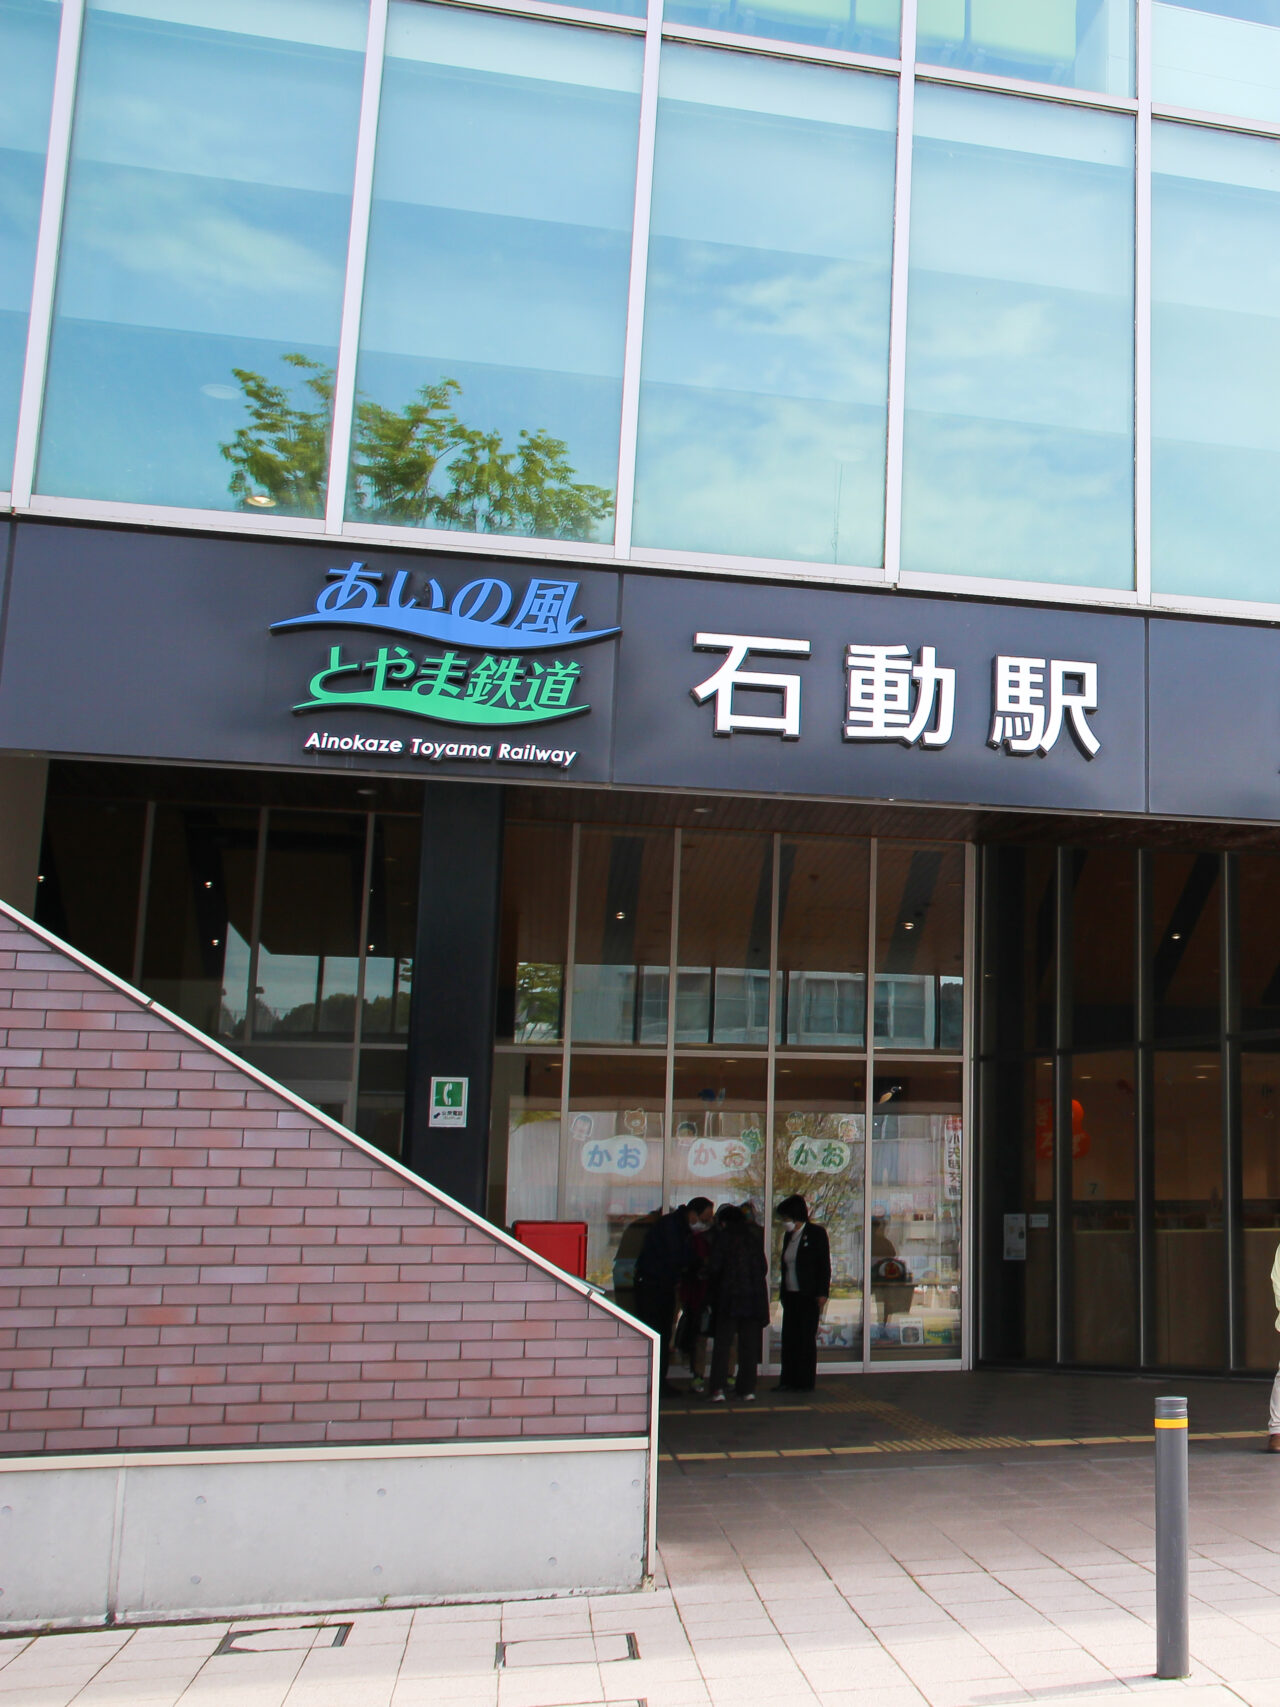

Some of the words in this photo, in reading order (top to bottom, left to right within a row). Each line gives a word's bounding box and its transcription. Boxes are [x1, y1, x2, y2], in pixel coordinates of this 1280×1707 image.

[315, 561, 586, 634] あいの風
[308, 645, 583, 711] とやま鉄道
[691, 632, 1101, 757] 石動駅
[305, 732, 403, 754] Ainokaze
[411, 737, 492, 760] Toyama
[498, 742, 577, 767] Railway
[587, 1145, 641, 1169] かお
[692, 1142, 747, 1168] かお
[792, 1142, 844, 1167] かお
